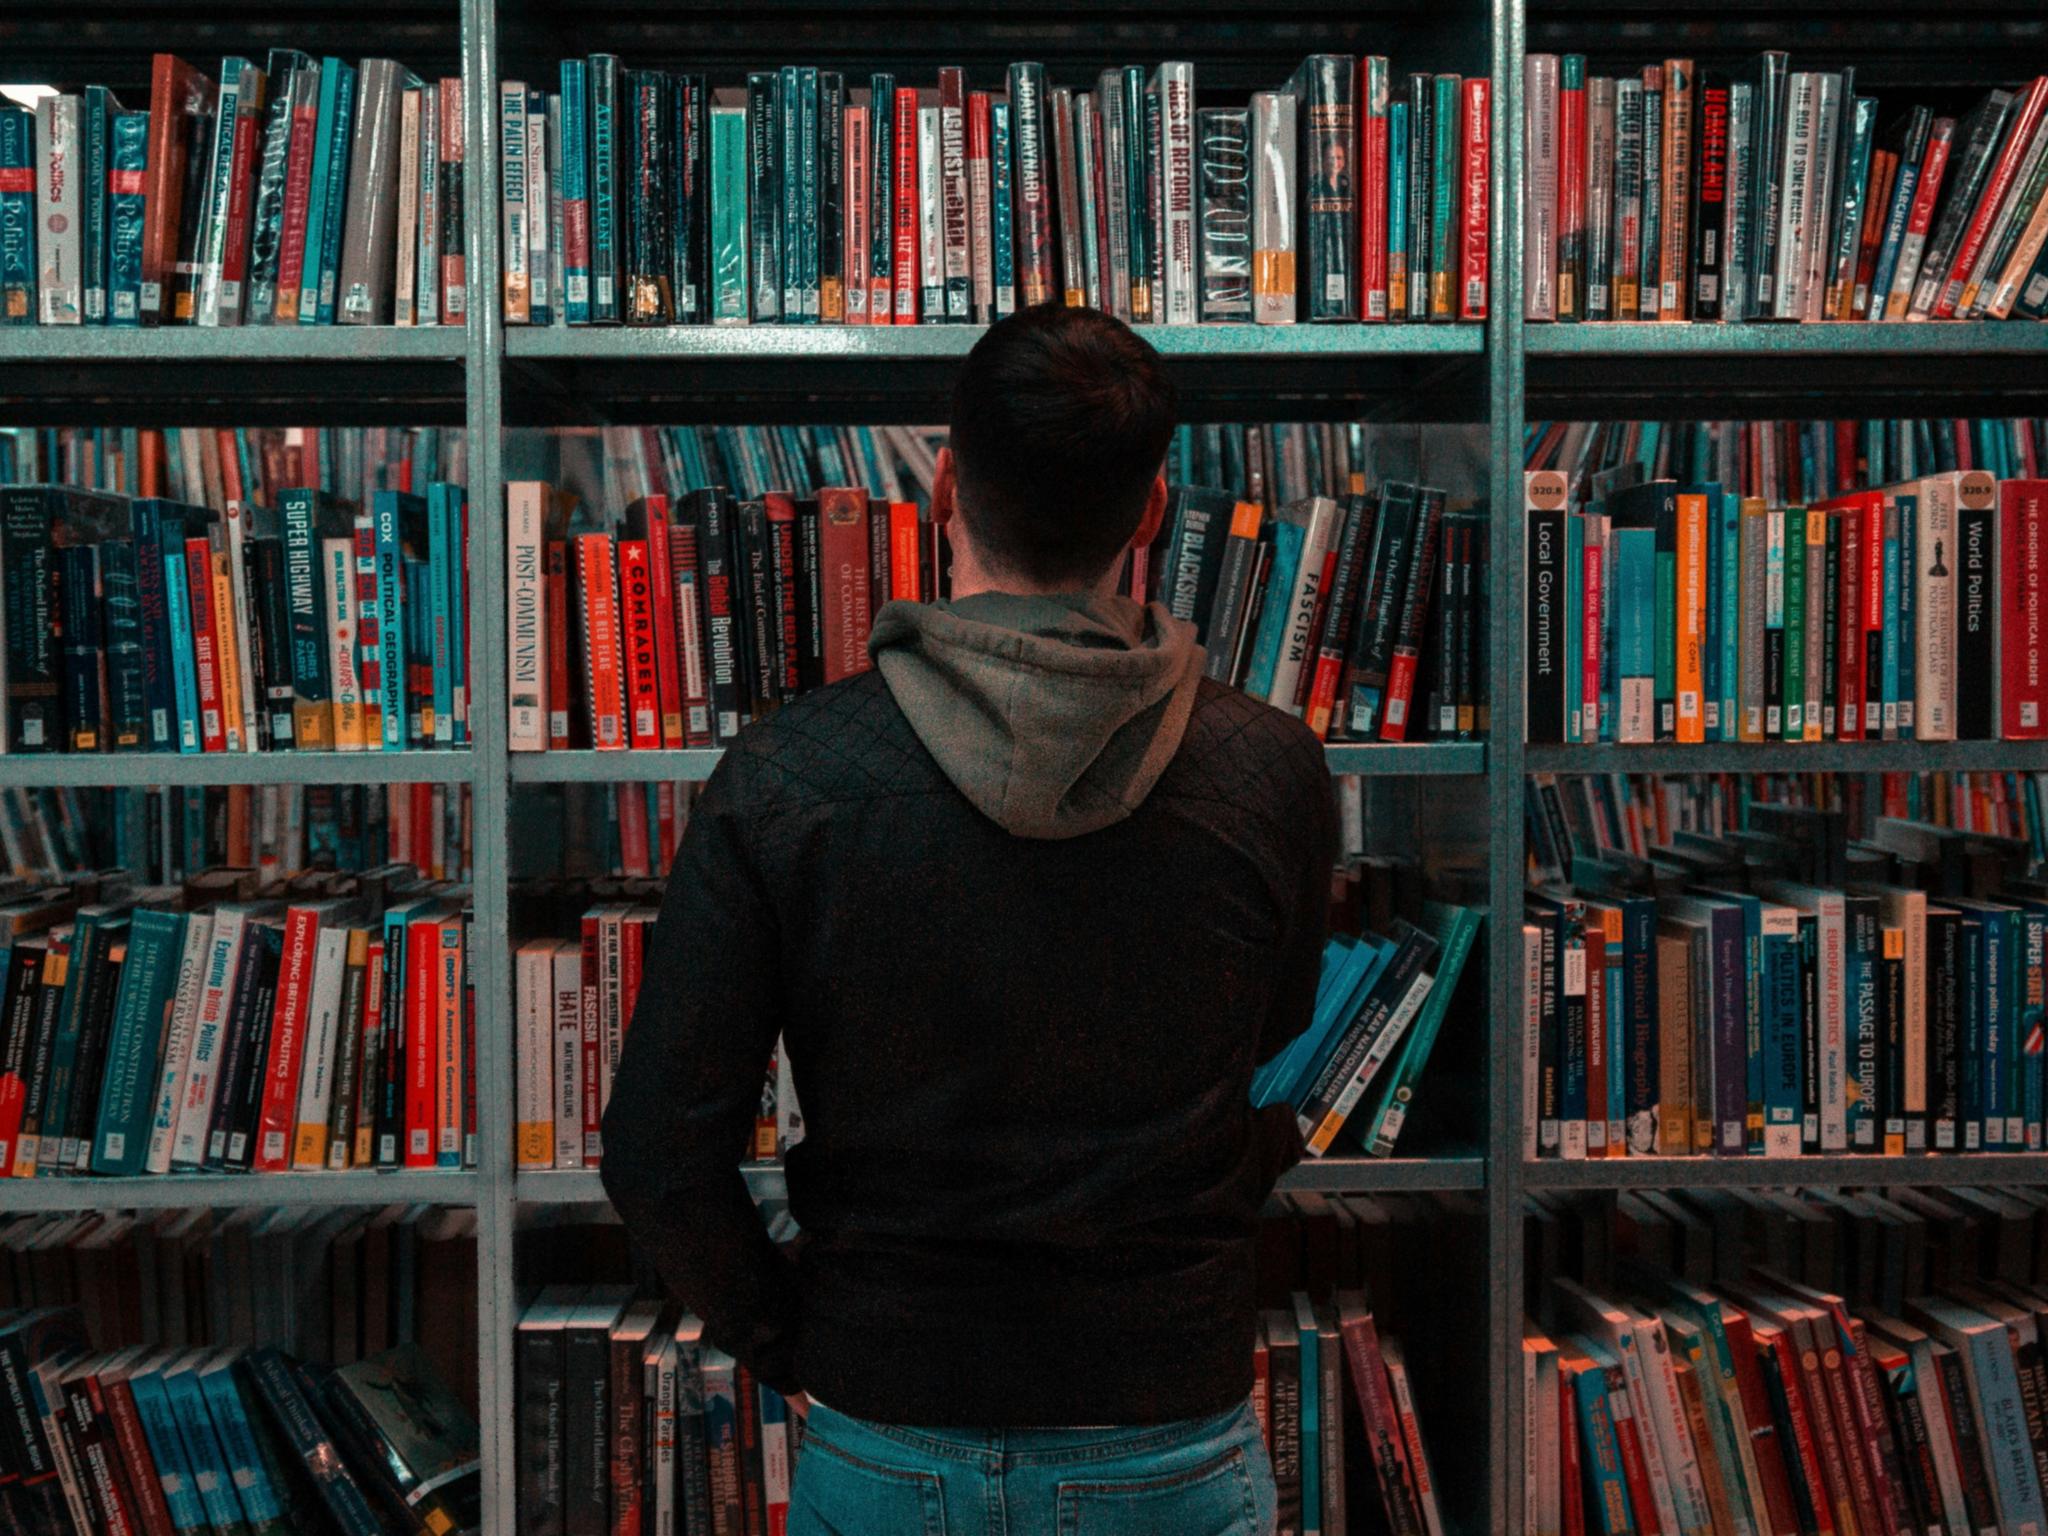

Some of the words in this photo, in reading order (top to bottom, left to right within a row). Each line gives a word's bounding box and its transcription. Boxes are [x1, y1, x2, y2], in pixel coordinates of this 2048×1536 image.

[504, 92, 521, 113] THE
[1019, 78, 1036, 120] JOAN
[1168, 80, 1189, 120] AGES
[1621, 91, 1640, 133] BOKO
[1798, 87, 1812, 103] THE
[219, 94, 234, 152] POLITICAL
[505, 120, 522, 155] PALIN
[530, 122, 541, 142] Leo
[1170, 124, 1189, 141] OF
[1542, 111, 1550, 130] INTO
[1795, 110, 1810, 137] ROAD
[4, 118, 17, 165] Oxford
[597, 103, 611, 184] AMERICA
[948, 107, 964, 176] AGAINST
[1542, 132, 1550, 159] CHAOS
[1702, 89, 1728, 202] HOMELAND
[1794, 143, 1807, 155] TO
[51, 152, 63, 202] Politics
[506, 161, 523, 203] EFFECT
[530, 146, 542, 185] Strauss
[1020, 124, 1038, 202] MAYNARD
[1170, 147, 1190, 212] REFORM
[1621, 139, 1639, 197] HARAM
[1737, 145, 1750, 191] SAVING
[1736, 195, 1750, 220] THE
[1790, 160, 1806, 225] SOMEWHERE
[1889, 169, 1917, 243] ANARCHISM
[4, 200, 21, 271] Politics
[116, 204, 137, 272] Politics
[598, 192, 612, 251] ALONE
[949, 198, 964, 246] GRAIN
[1173, 220, 1182, 261] MORGAN
[899, 235, 912, 252] LIZ
[1735, 222, 1750, 267] PEOPLE
[1533, 486, 1562, 495] 320.8
[1963, 486, 1991, 495] 320.9
[2029, 498, 2038, 521] THE
[286, 501, 308, 547] SUPER
[381, 512, 392, 543] COX
[708, 502, 718, 536] PONS
[1872, 502, 1880, 540] SCOTTISH
[1902, 505, 1911, 547] Devolution
[35, 547, 46, 565] The
[750, 549, 763, 569] The
[780, 524, 794, 577] UNDER
[1388, 538, 1402, 556] The
[1538, 522, 1552, 564] Local
[1872, 542, 1880, 567] LOCAL
[1903, 549, 1910, 557] in
[1968, 522, 1982, 568] World
[2028, 525, 2038, 569] ORIGINS
[36, 568, 46, 604] Oxford
[290, 551, 313, 615] HIGHWAY
[708, 560, 720, 575] The
[752, 573, 764, 592] End
[841, 564, 852, 585] OF
[855, 568, 865, 593] THE
[1172, 532, 1205, 621] BLACKSHIR
[1381, 559, 1400, 593] Oxford
[1902, 560, 1910, 586] Britain
[2028, 573, 2038, 588] OF
[383, 553, 395, 626] POLITICAL
[594, 597, 607, 616] THE
[708, 576, 729, 615] Global
[754, 596, 766, 606] of
[783, 580, 794, 611] THE
[1871, 570, 1880, 625] GOVERNMENT
[1900, 589, 1910, 611] today
[1968, 575, 1982, 632] Politics
[516, 545, 536, 682] POST-COMMUNISM
[596, 620, 608, 640] RED
[632, 566, 652, 694] COMRADES
[784, 615, 796, 643] RED
[842, 588, 854, 672] COMMUNISM
[856, 597, 866, 623] RISE
[1289, 573, 1320, 662] FASCISM
[1373, 595, 1394, 643] Handbook
[1537, 570, 1553, 675] Government
[2028, 592, 2038, 645] POLITICAL
[36, 608, 48, 658] Handbook
[197, 636, 212, 660] STATE
[711, 617, 733, 685] Revolution
[755, 608, 769, 666] Communist
[857, 628, 866, 637] &
[37, 662, 48, 675] of
[295, 639, 307, 680] PARRY
[305, 641, 318, 678] CHRIS
[386, 631, 398, 718] GEOGRAPHY
[598, 645, 611, 671] FLAG
[784, 647, 798, 688] FLAG
[857, 641, 868, 669] FALL
[1688, 641, 1696, 673] COPUS
[2028, 650, 2038, 686] ORDER
[197, 663, 214, 700] BUILDING
[757, 669, 771, 699] Power
[145, 941, 158, 967] THE
[208, 940, 230, 986] Exploring
[288, 916, 307, 980] EXPLORING
[1544, 928, 1554, 962] AFTER
[1828, 928, 1838, 990] EUROPEAN
[1988, 939, 1998, 984] European
[1544, 966, 1554, 987] THE
[1632, 953, 1649, 1020] Political
[1860, 961, 1871, 978] THE
[137, 971, 154, 1021] BRITISH
[167, 958, 193, 1064] CONSERVATISM
[204, 989, 219, 1022] British
[284, 983, 297, 1026] BRITISH
[559, 991, 578, 1031] HATE
[584, 986, 597, 1042] FASCISM
[1544, 990, 1554, 1016] FALL
[1859, 983, 1872, 1039] PASSAGE
[1987, 988, 1998, 1020] politics
[1364, 1004, 1389, 1034] ARAB
[1591, 1013, 1600, 1065] REVOLUTION
[1782, 1012, 1796, 1028] IN
[1828, 994, 1838, 1044] POLITICS
[1986, 1023, 1998, 1053] today
[197, 1024, 217, 1062] Politics
[277, 1028, 292, 1078] POLITICS
[563, 1042, 574, 1081] MATTHEW
[1782, 1033, 1796, 1090] EUROPE
[1859, 1042, 1872, 1057] TO
[120, 1024, 146, 1123] CONSTITUTION
[1321, 1037, 1372, 1104] NATIONALISM
[1632, 1024, 1653, 1106] Biography
[564, 1085, 574, 1118] COLLINS
[1859, 1061, 1874, 1112] EUROPE
[660, 1372, 672, 1412] Orange
[620, 1405, 633, 1433] The
[2010, 1449, 2032, 1502] BRITAIN
